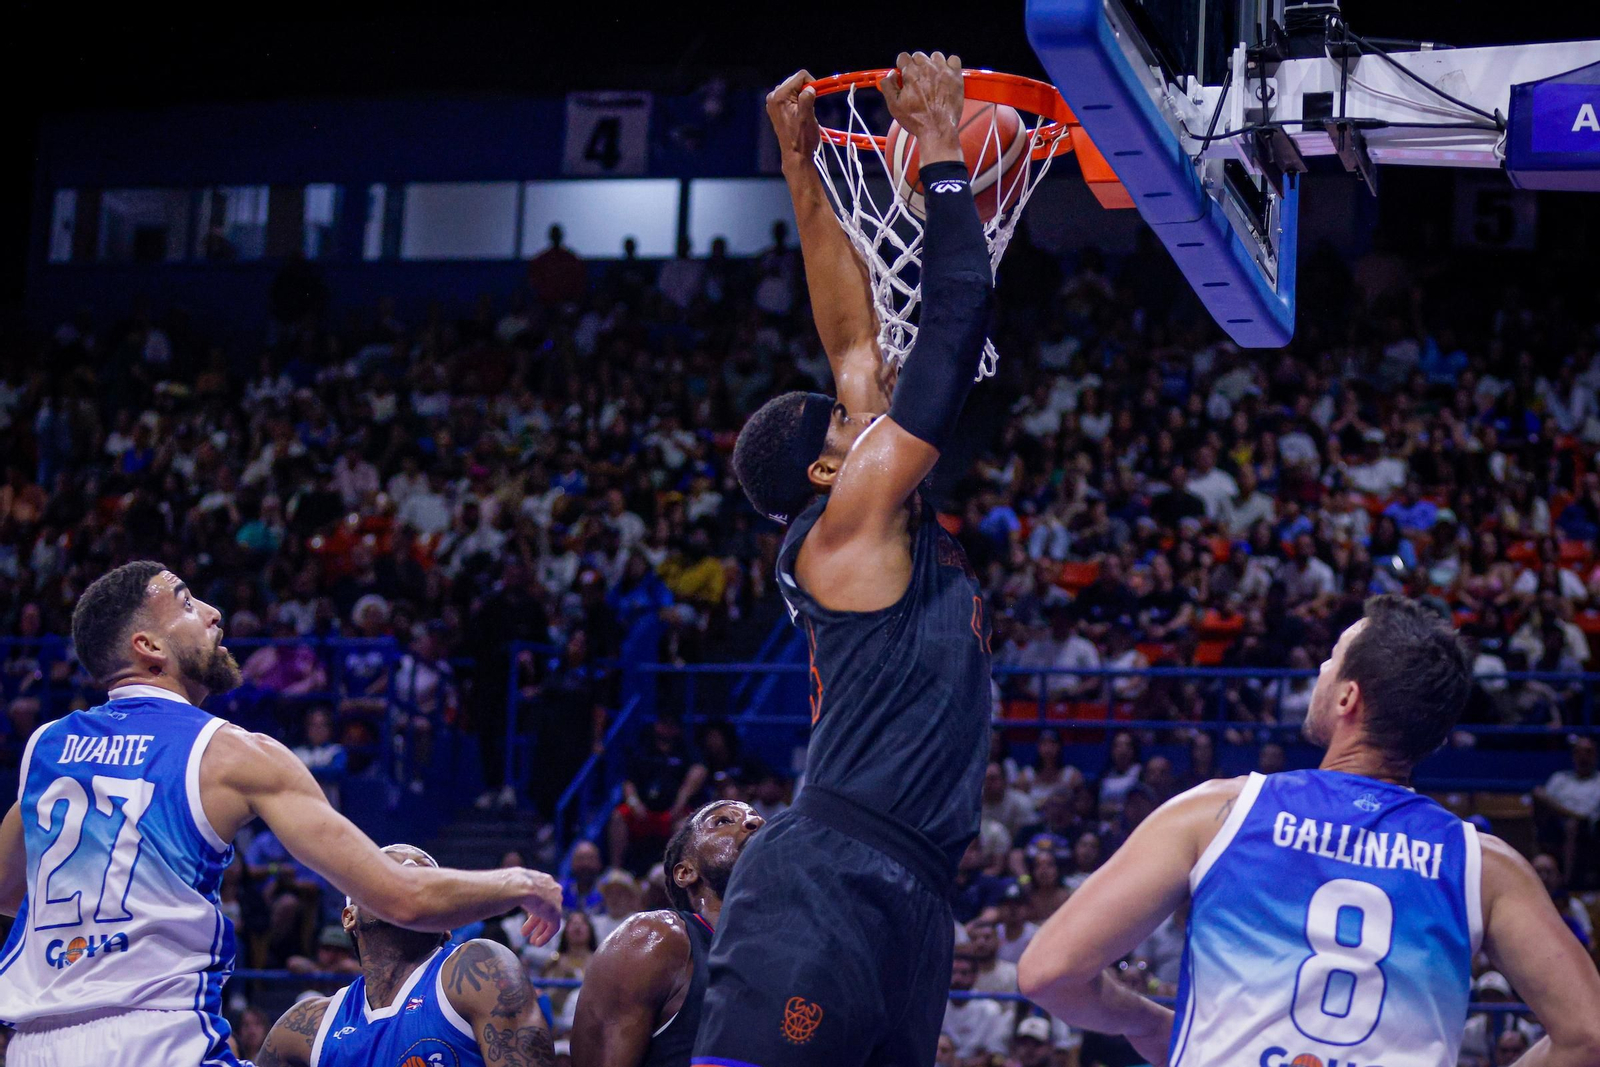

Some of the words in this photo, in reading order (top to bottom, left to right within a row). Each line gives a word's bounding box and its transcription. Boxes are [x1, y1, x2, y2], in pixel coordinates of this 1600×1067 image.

[584, 116, 621, 169] 4
[1475, 190, 1514, 243] 5
[57, 734, 155, 765] DUARTE
[33, 775, 155, 932] 27
[1273, 811, 1444, 879] GALLINARI
[1290, 878, 1393, 1046] 8
